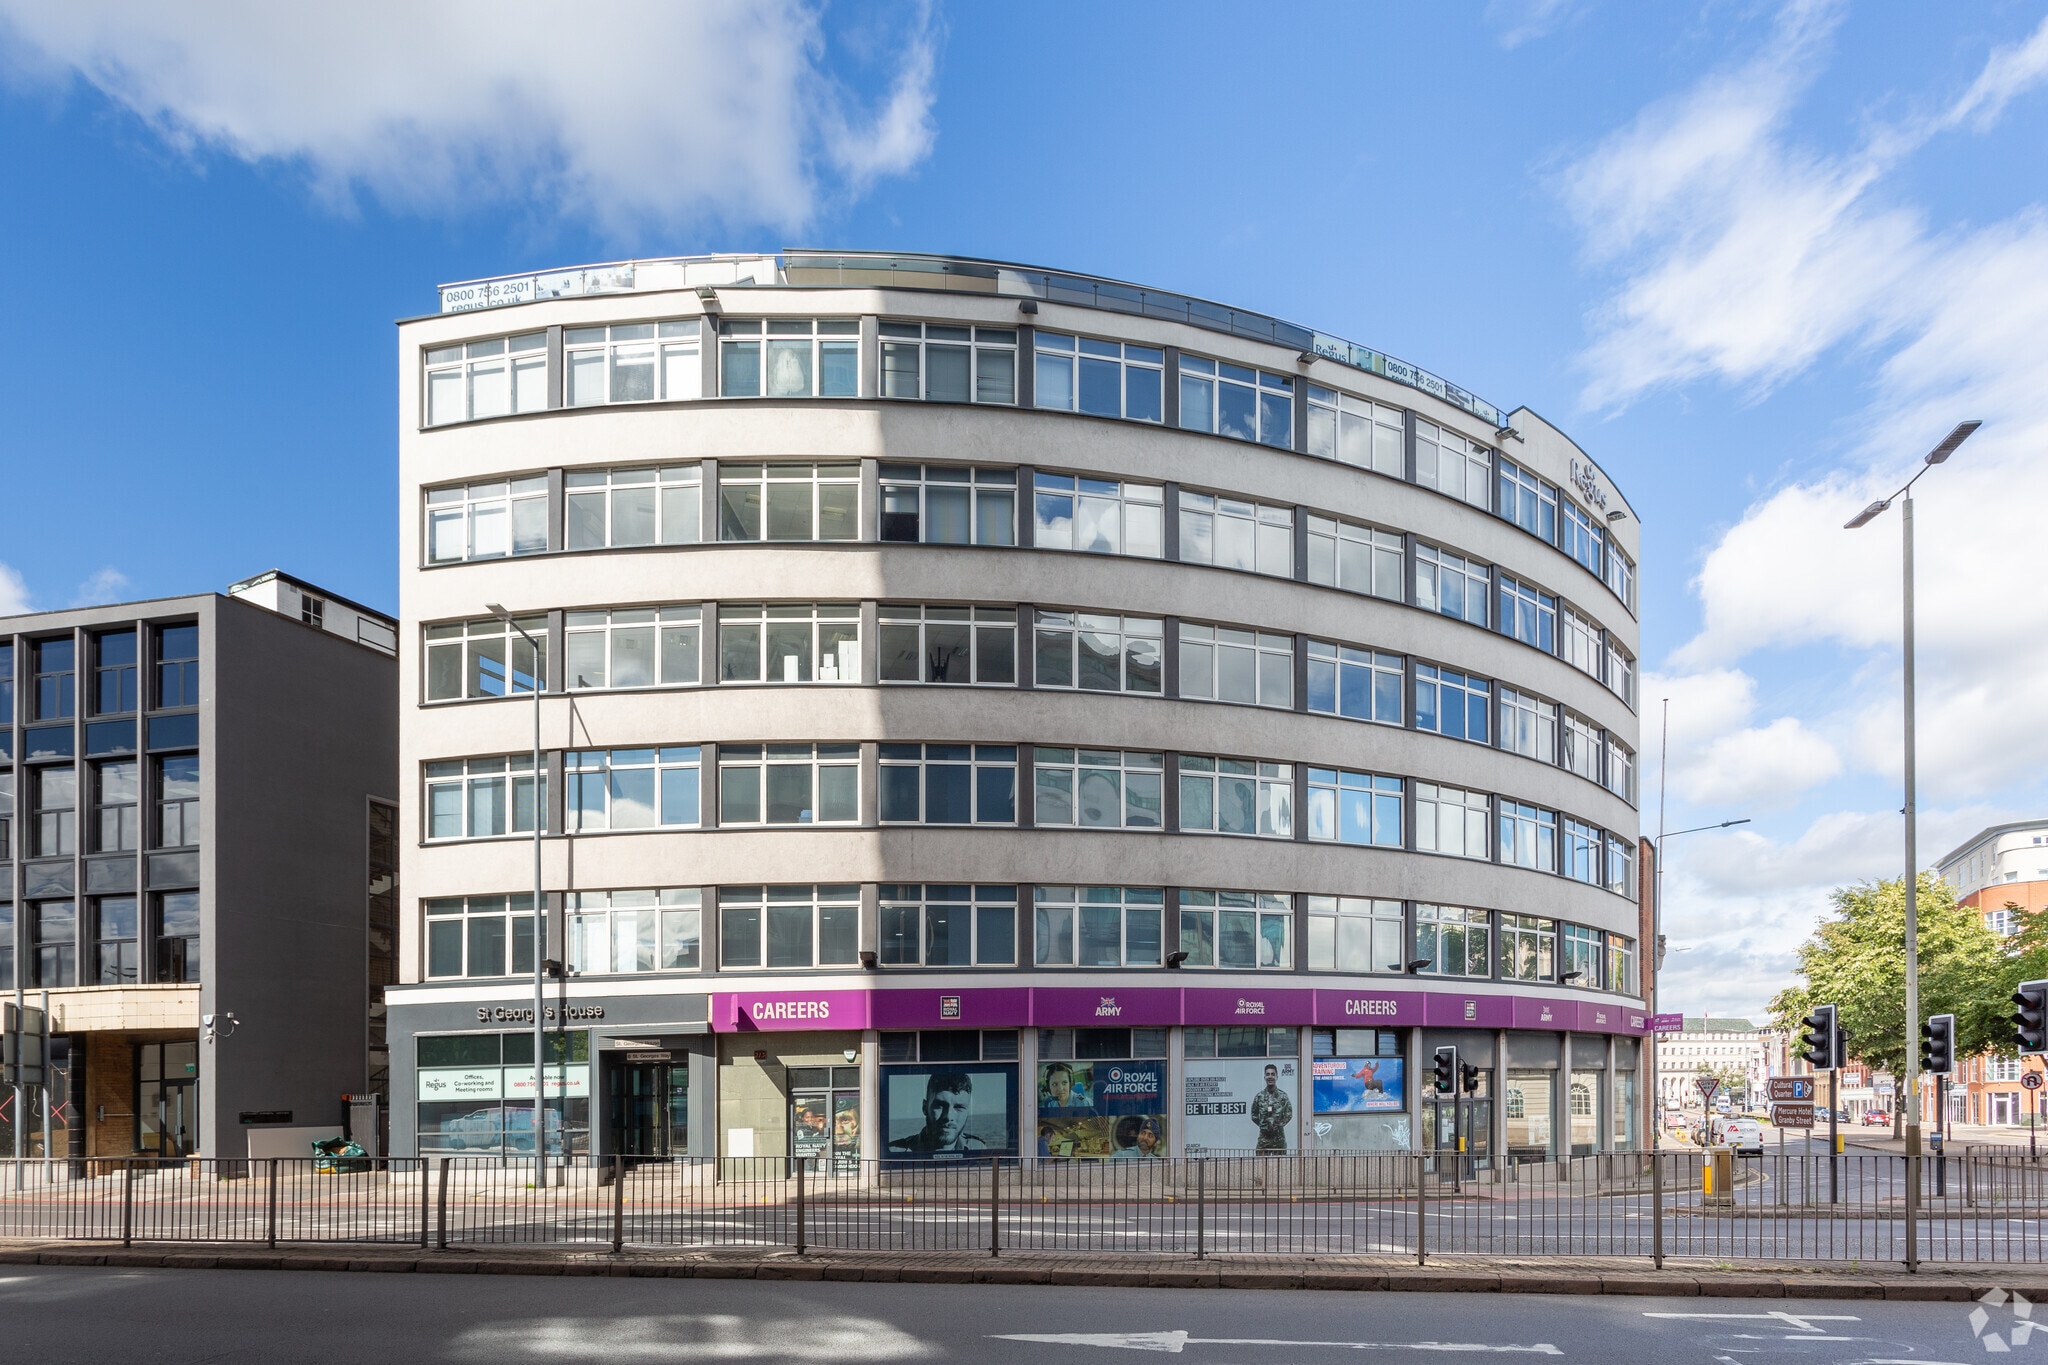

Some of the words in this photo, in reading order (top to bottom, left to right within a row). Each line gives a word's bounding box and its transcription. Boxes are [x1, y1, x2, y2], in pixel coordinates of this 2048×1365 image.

[446, 289, 474, 303] 0800
[478, 285, 500, 299] 756
[503, 281, 529, 295] 2501
[1387, 361, 1408, 377] 0800
[1426, 377, 1444, 393] 2501
[476, 1007, 490, 1020] St
[494, 1004, 553, 1022] Georg's
[752, 1001, 830, 1020] CAREERS
[1095, 1006, 1122, 1017] ARMY
[1345, 999, 1397, 1016] CAREERS
[1654, 1024, 1681, 1032] CAREERS
[1124, 1072, 1158, 1082] ROYAL
[426, 1080, 446, 1091] Regus
[1103, 1084, 1123, 1094] AIR
[1124, 1082, 1158, 1093] FORCE
[1186, 1104, 1199, 1115] BE
[1201, 1104, 1220, 1114] THE
[1222, 1103, 1245, 1114] BEST
[1778, 1107, 1797, 1115] Mercure
[1799, 1107, 1813, 1115] Hotel
[1778, 1117, 1795, 1125] Granby
